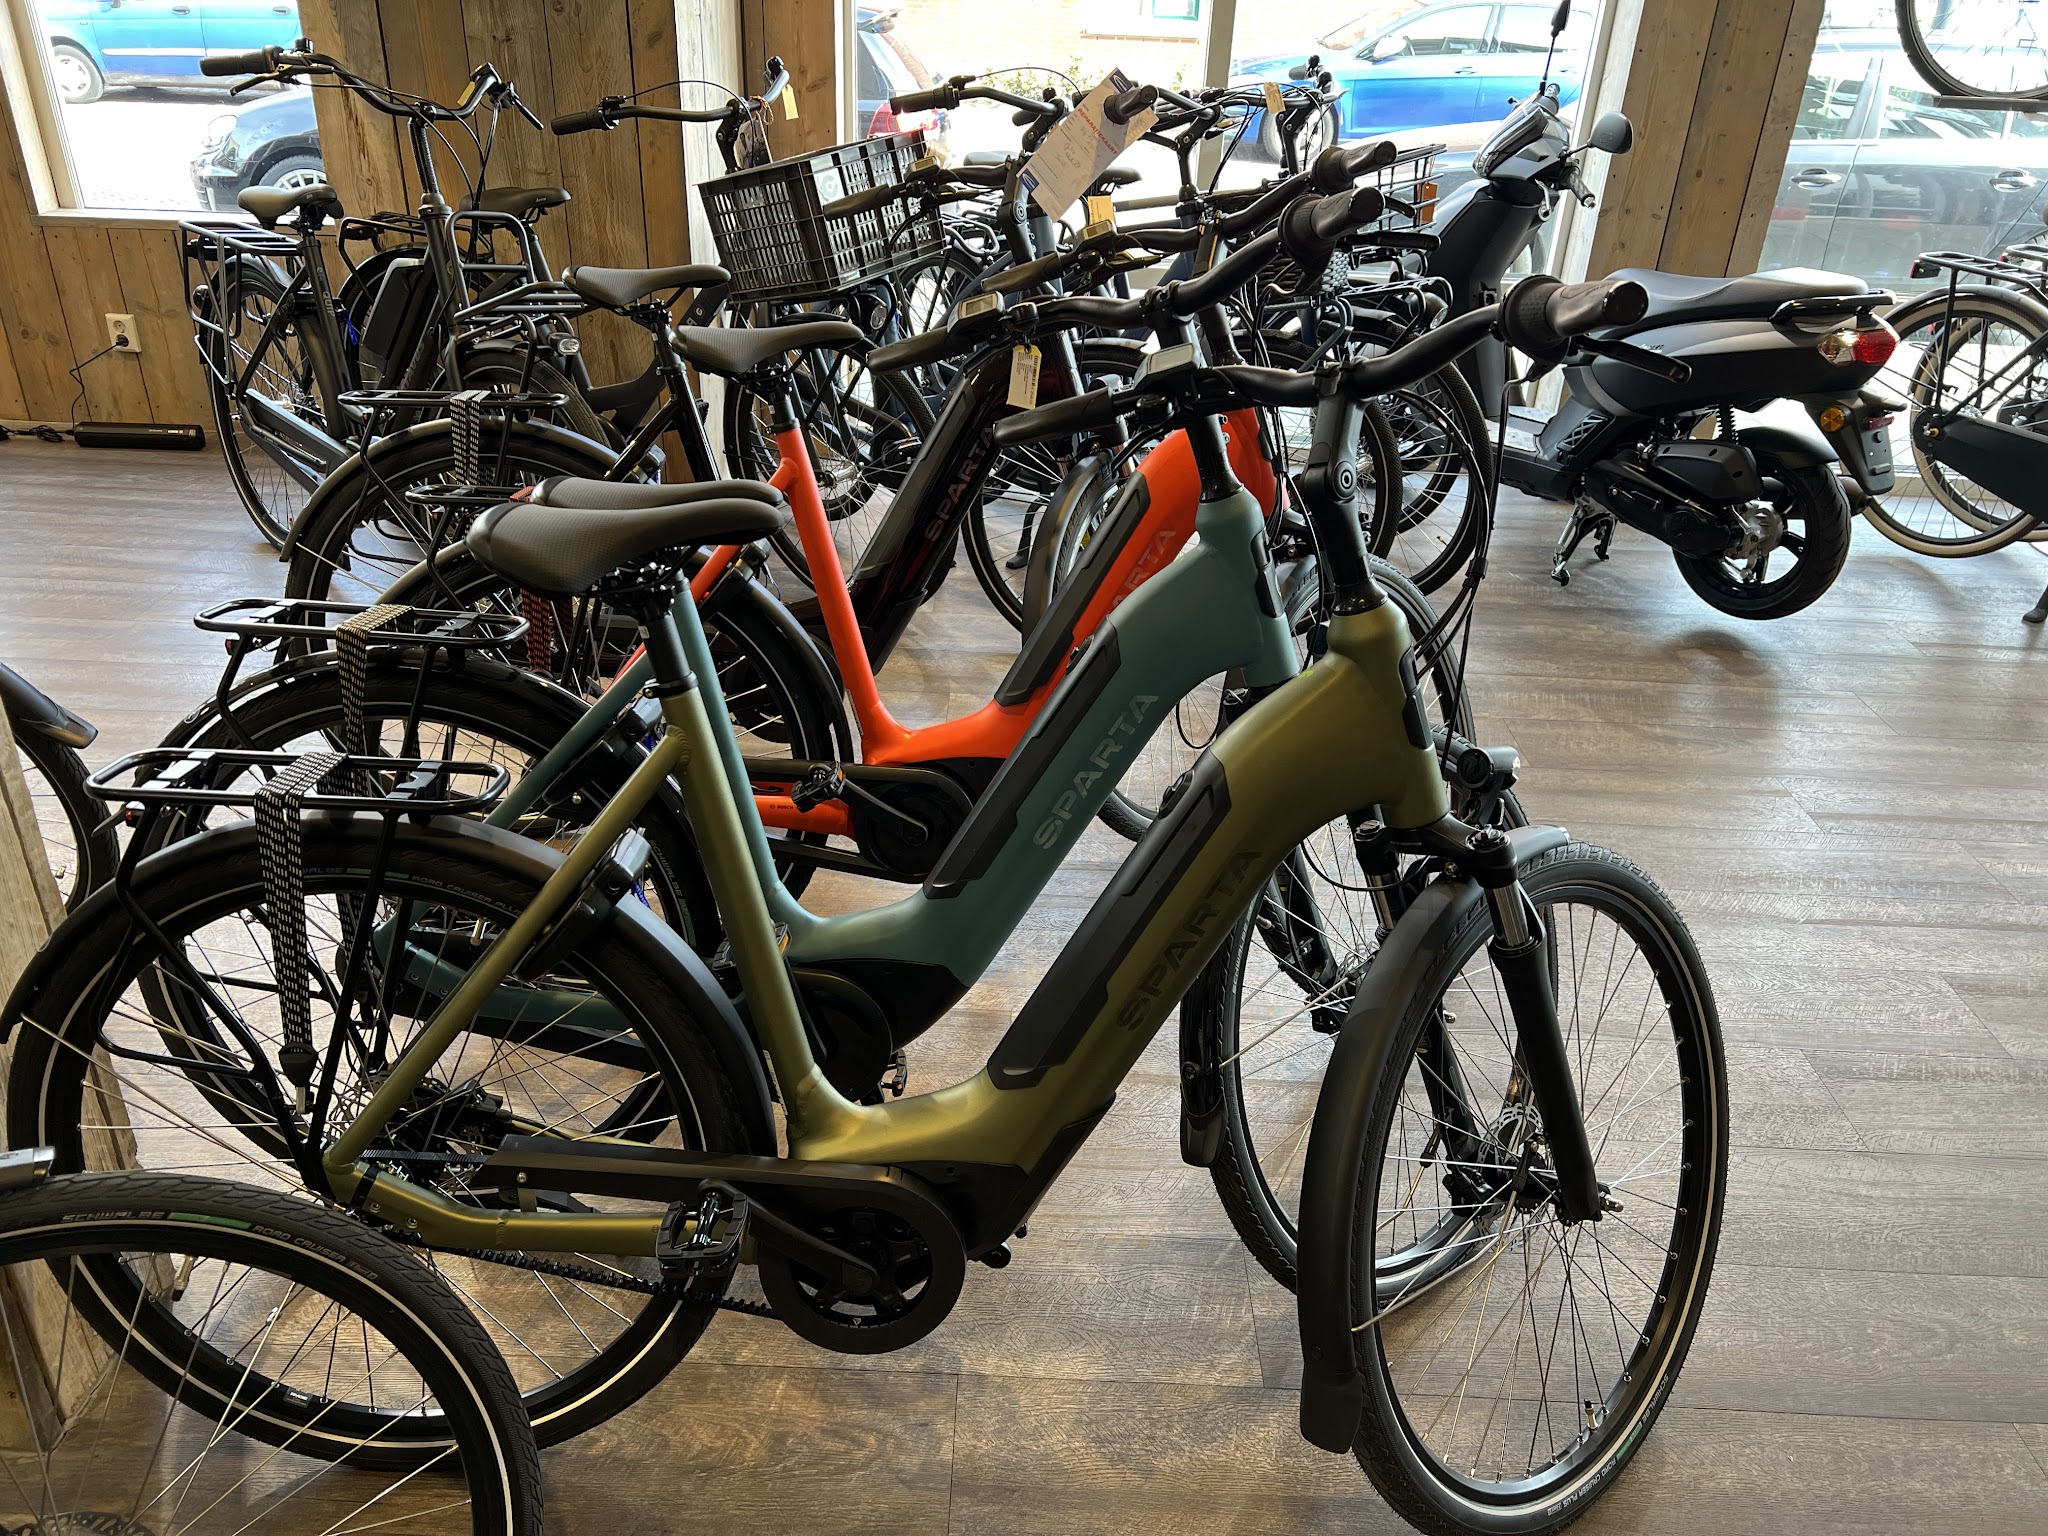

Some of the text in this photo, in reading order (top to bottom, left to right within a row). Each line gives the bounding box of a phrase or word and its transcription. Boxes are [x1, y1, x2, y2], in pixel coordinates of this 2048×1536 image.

[1077, 108, 1118, 155] REPARATIEKAART
[924, 427, 993, 541] SPARTA
[1112, 530, 1177, 608] RTA
[1032, 695, 1160, 850] SPARTA
[411, 875, 443, 887] ROAD
[447, 884, 493, 903] CRUISER
[650, 840, 683, 897] SCHWALBE
[1115, 851, 1262, 1031] SPARTA
[1232, 923, 1249, 994] SCHWALBE
[61, 1211, 347, 1262] SCHWALBE ROAD CRUISER
[1562, 1373, 1669, 1508] SCHWALBE ROAD CRUISER PLUS
